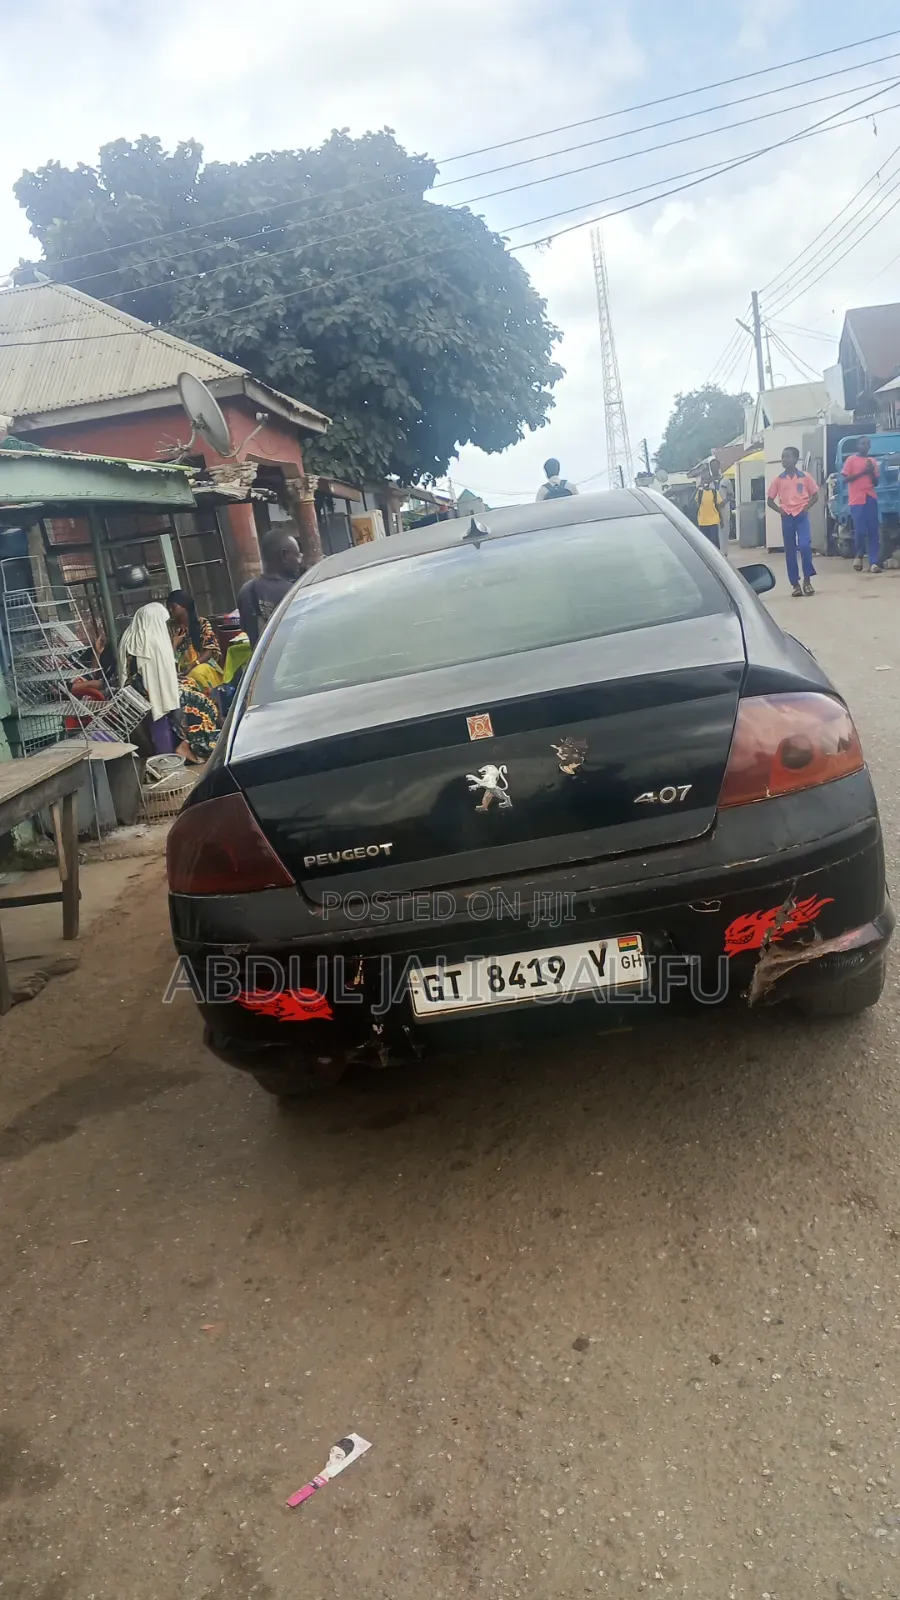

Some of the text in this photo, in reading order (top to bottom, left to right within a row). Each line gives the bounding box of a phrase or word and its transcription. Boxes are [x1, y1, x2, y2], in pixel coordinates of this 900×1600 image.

[634, 784, 693, 804] 407
[303, 842, 393, 868] PEUGEOT
[621, 953, 642, 969] GH
[423, 945, 608, 1003] GT 8419 Y
